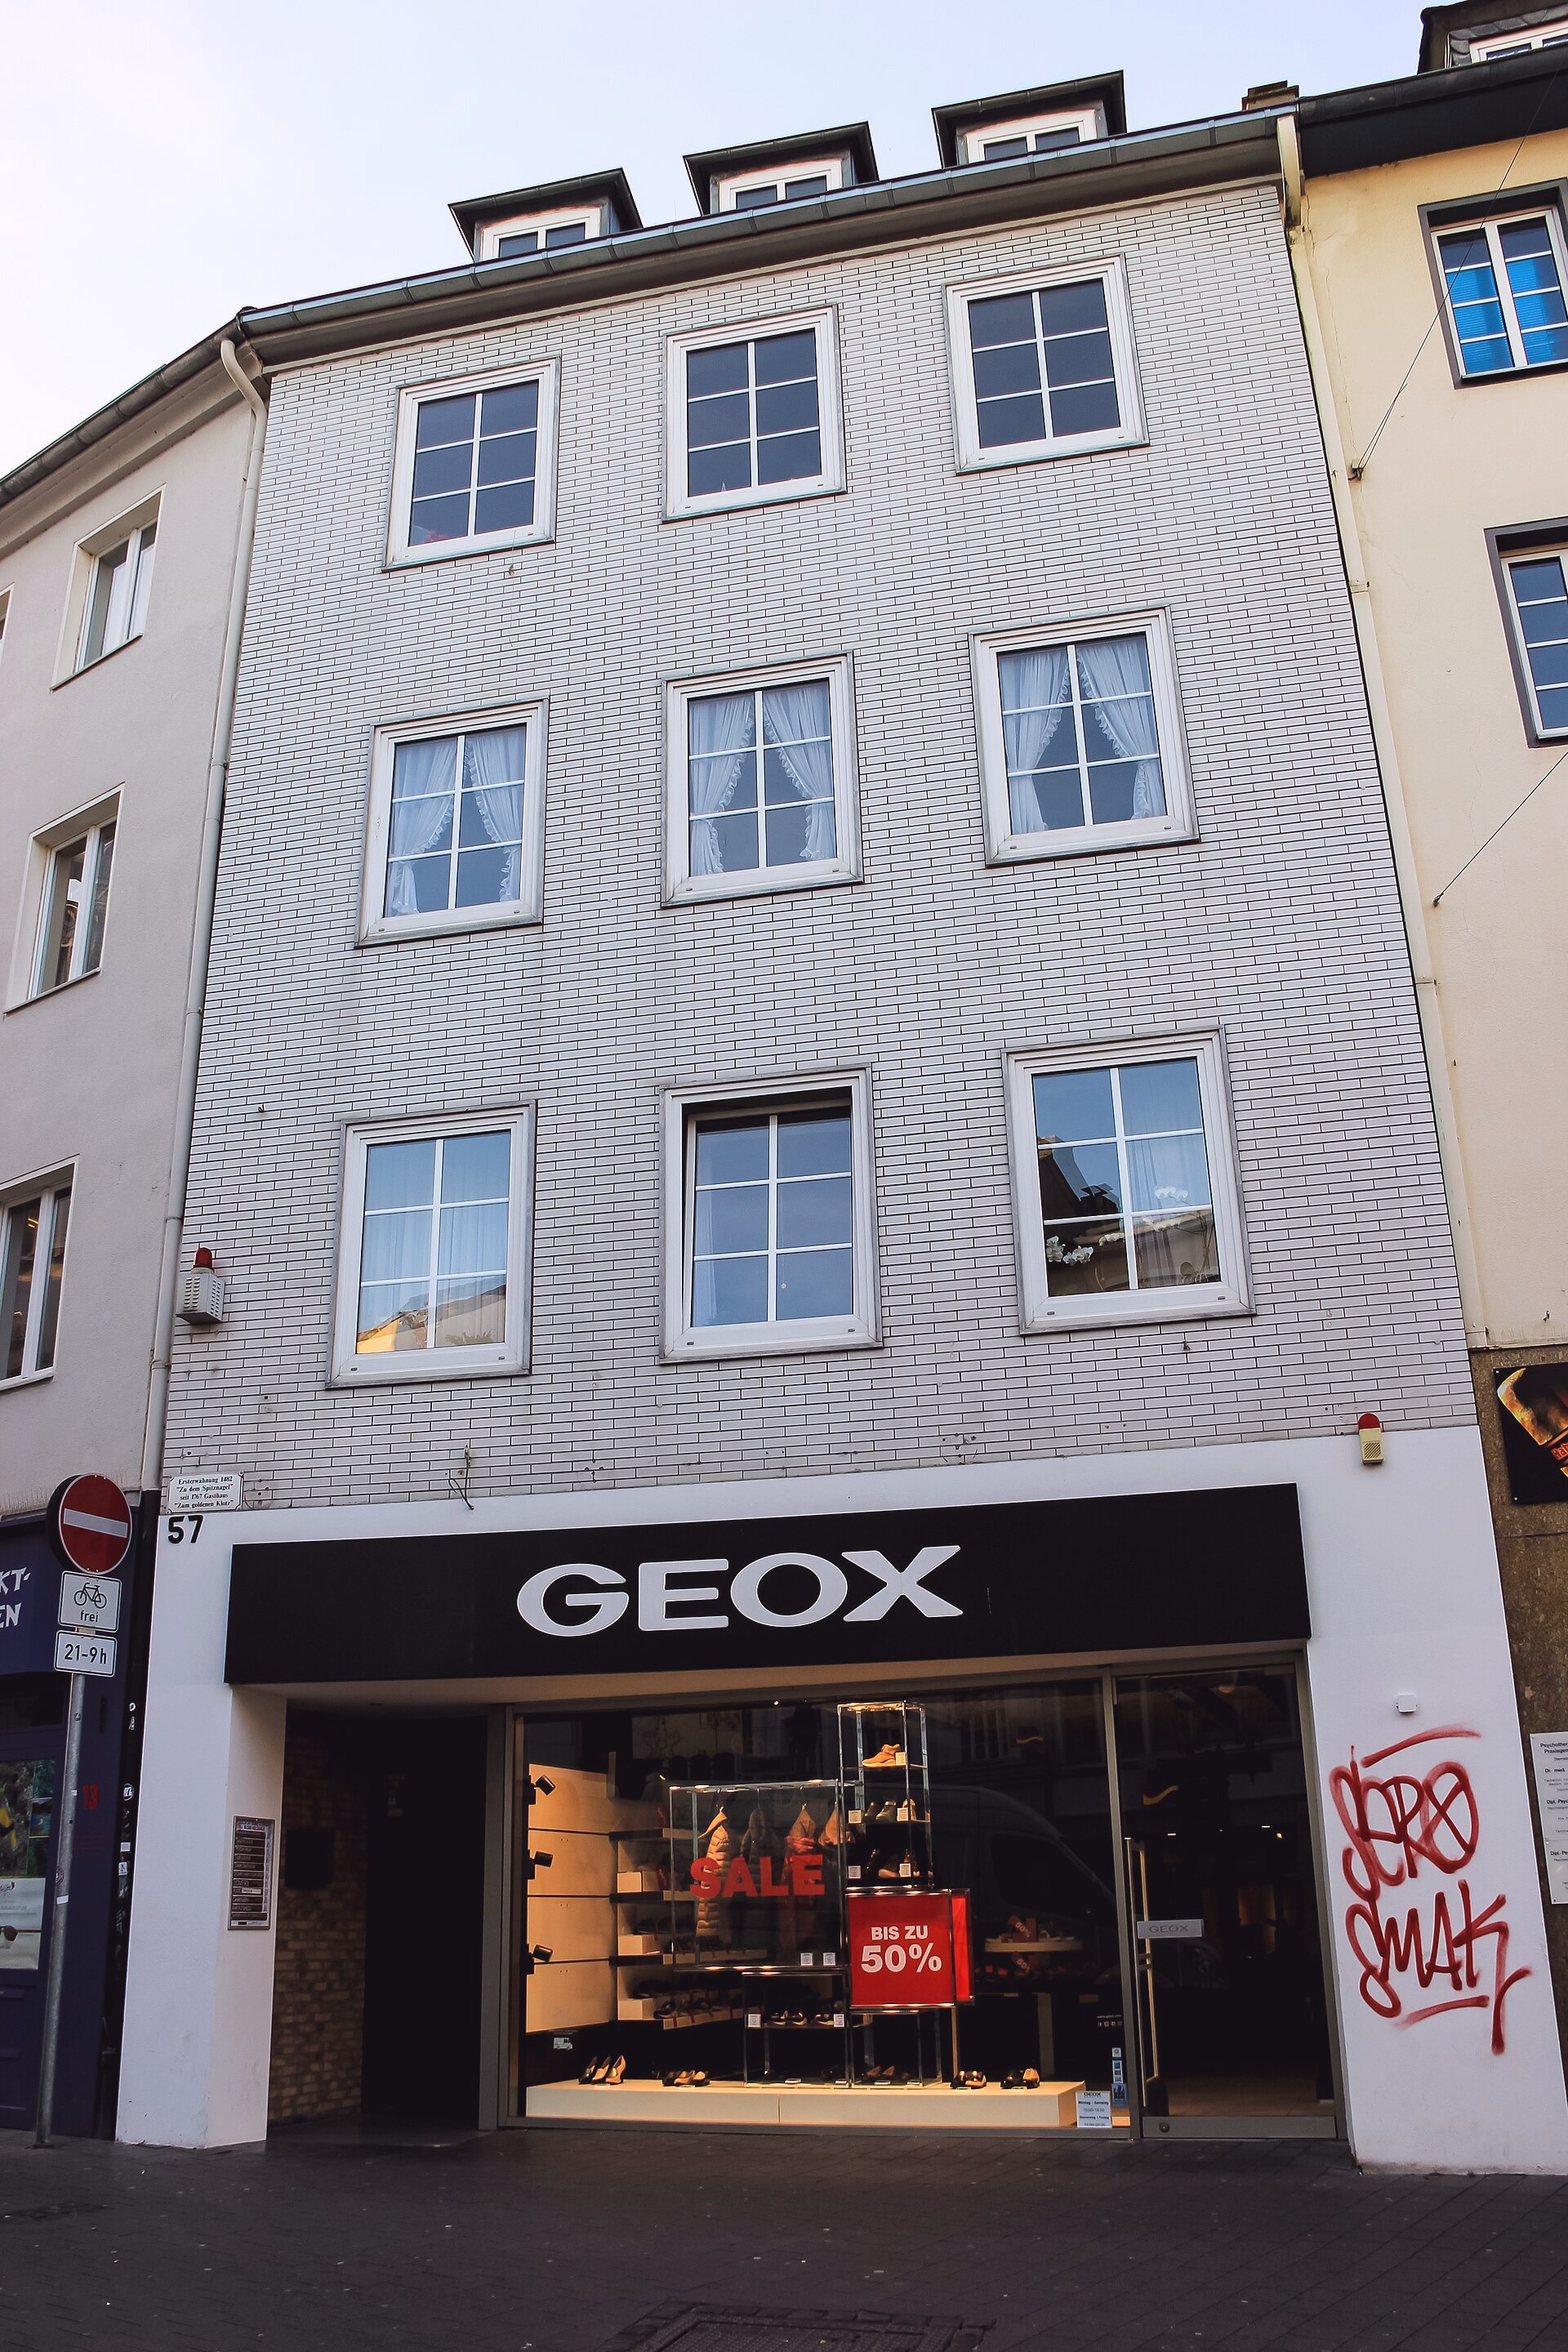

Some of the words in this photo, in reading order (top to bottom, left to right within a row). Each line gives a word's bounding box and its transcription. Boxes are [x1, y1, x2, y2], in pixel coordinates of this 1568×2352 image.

[167, 1514, 204, 1544] 57
[517, 1544, 964, 1637] GEOX
[80, 1610, 99, 1623] frei
[690, 1854, 826, 1899] SALE
[871, 1926, 899, 1940] BIS
[904, 1925, 929, 1940] ZU
[1148, 1925, 1189, 1933] GEOX
[861, 1942, 942, 1973] 50%
